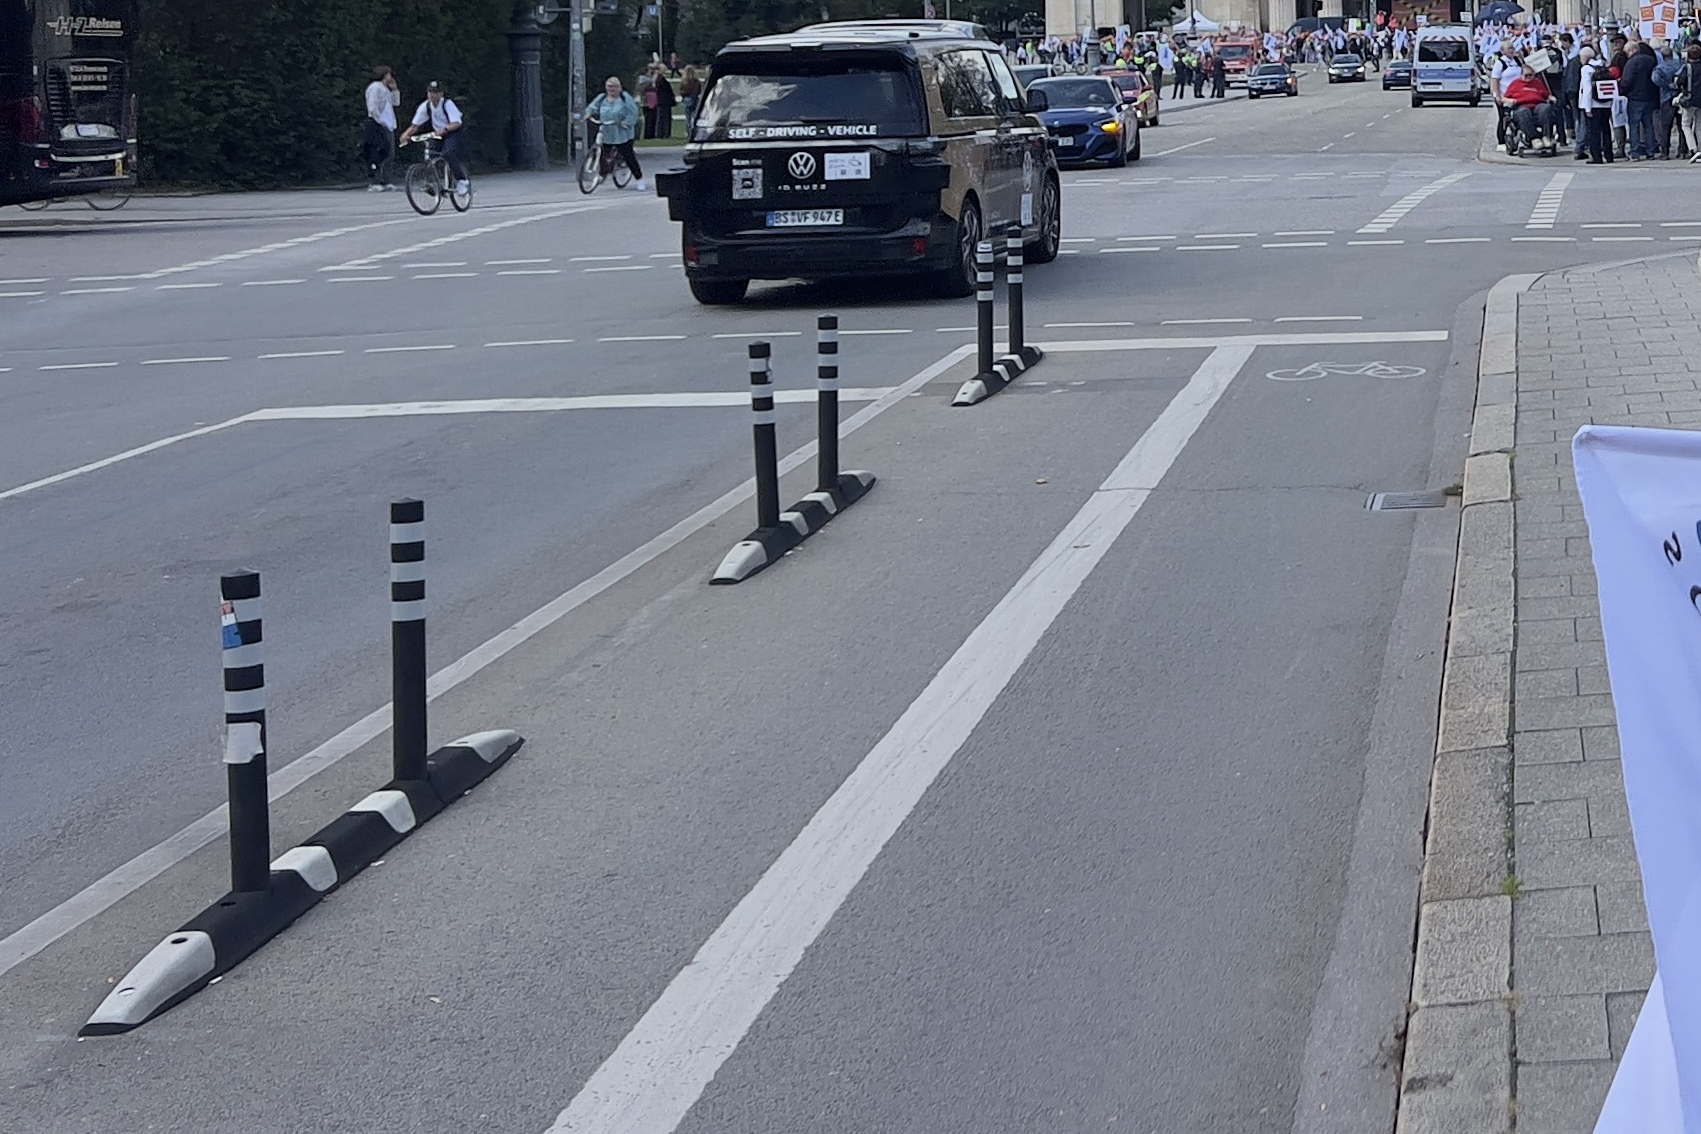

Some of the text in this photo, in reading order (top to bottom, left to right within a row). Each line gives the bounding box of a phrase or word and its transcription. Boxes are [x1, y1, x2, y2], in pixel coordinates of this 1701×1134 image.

[728, 128, 756, 139] SELF
[766, 125, 817, 137] DRIVING
[827, 125, 877, 136] VEHICLE
